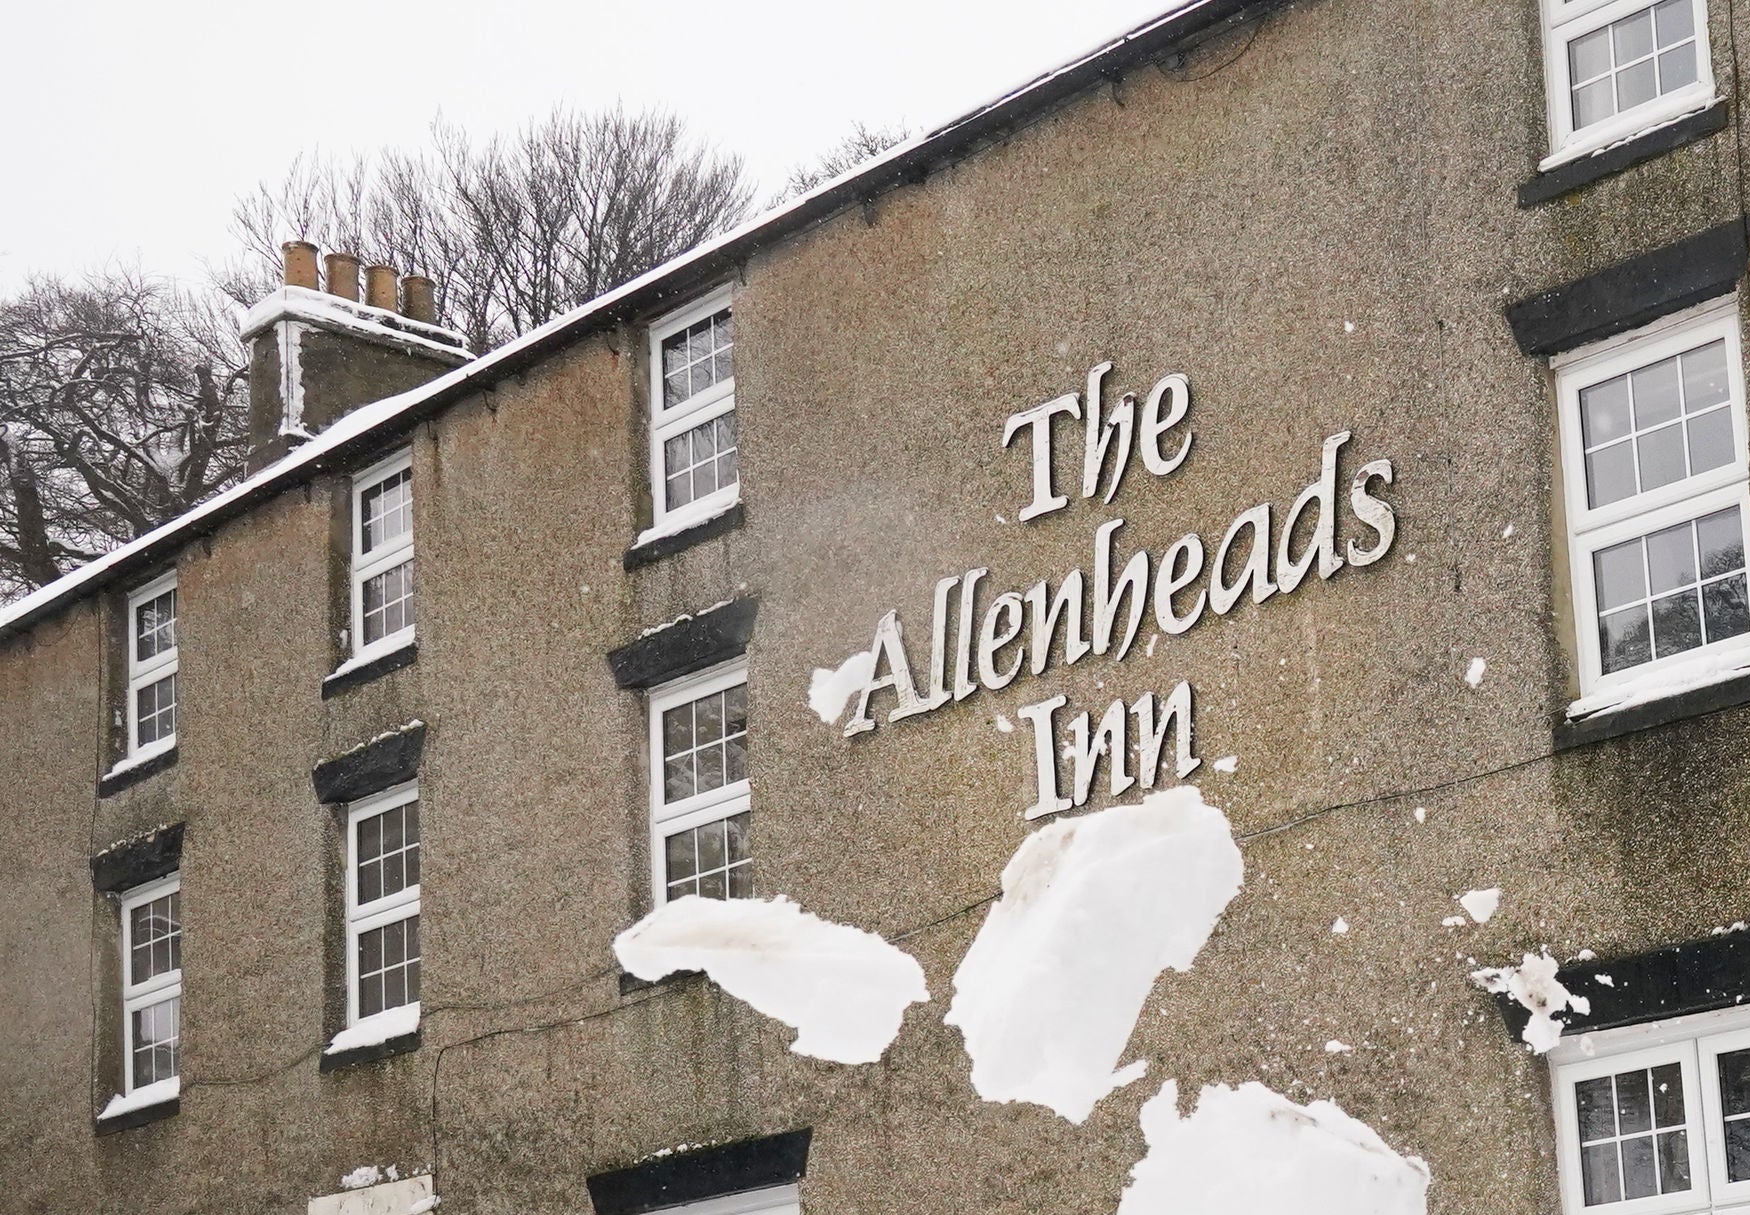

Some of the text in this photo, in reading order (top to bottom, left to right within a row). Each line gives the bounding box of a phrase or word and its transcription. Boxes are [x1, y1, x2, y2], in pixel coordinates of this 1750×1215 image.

[1001, 360, 1193, 522] The
[842, 430, 1397, 738] Allenheads
[1018, 680, 1202, 820] Inn
